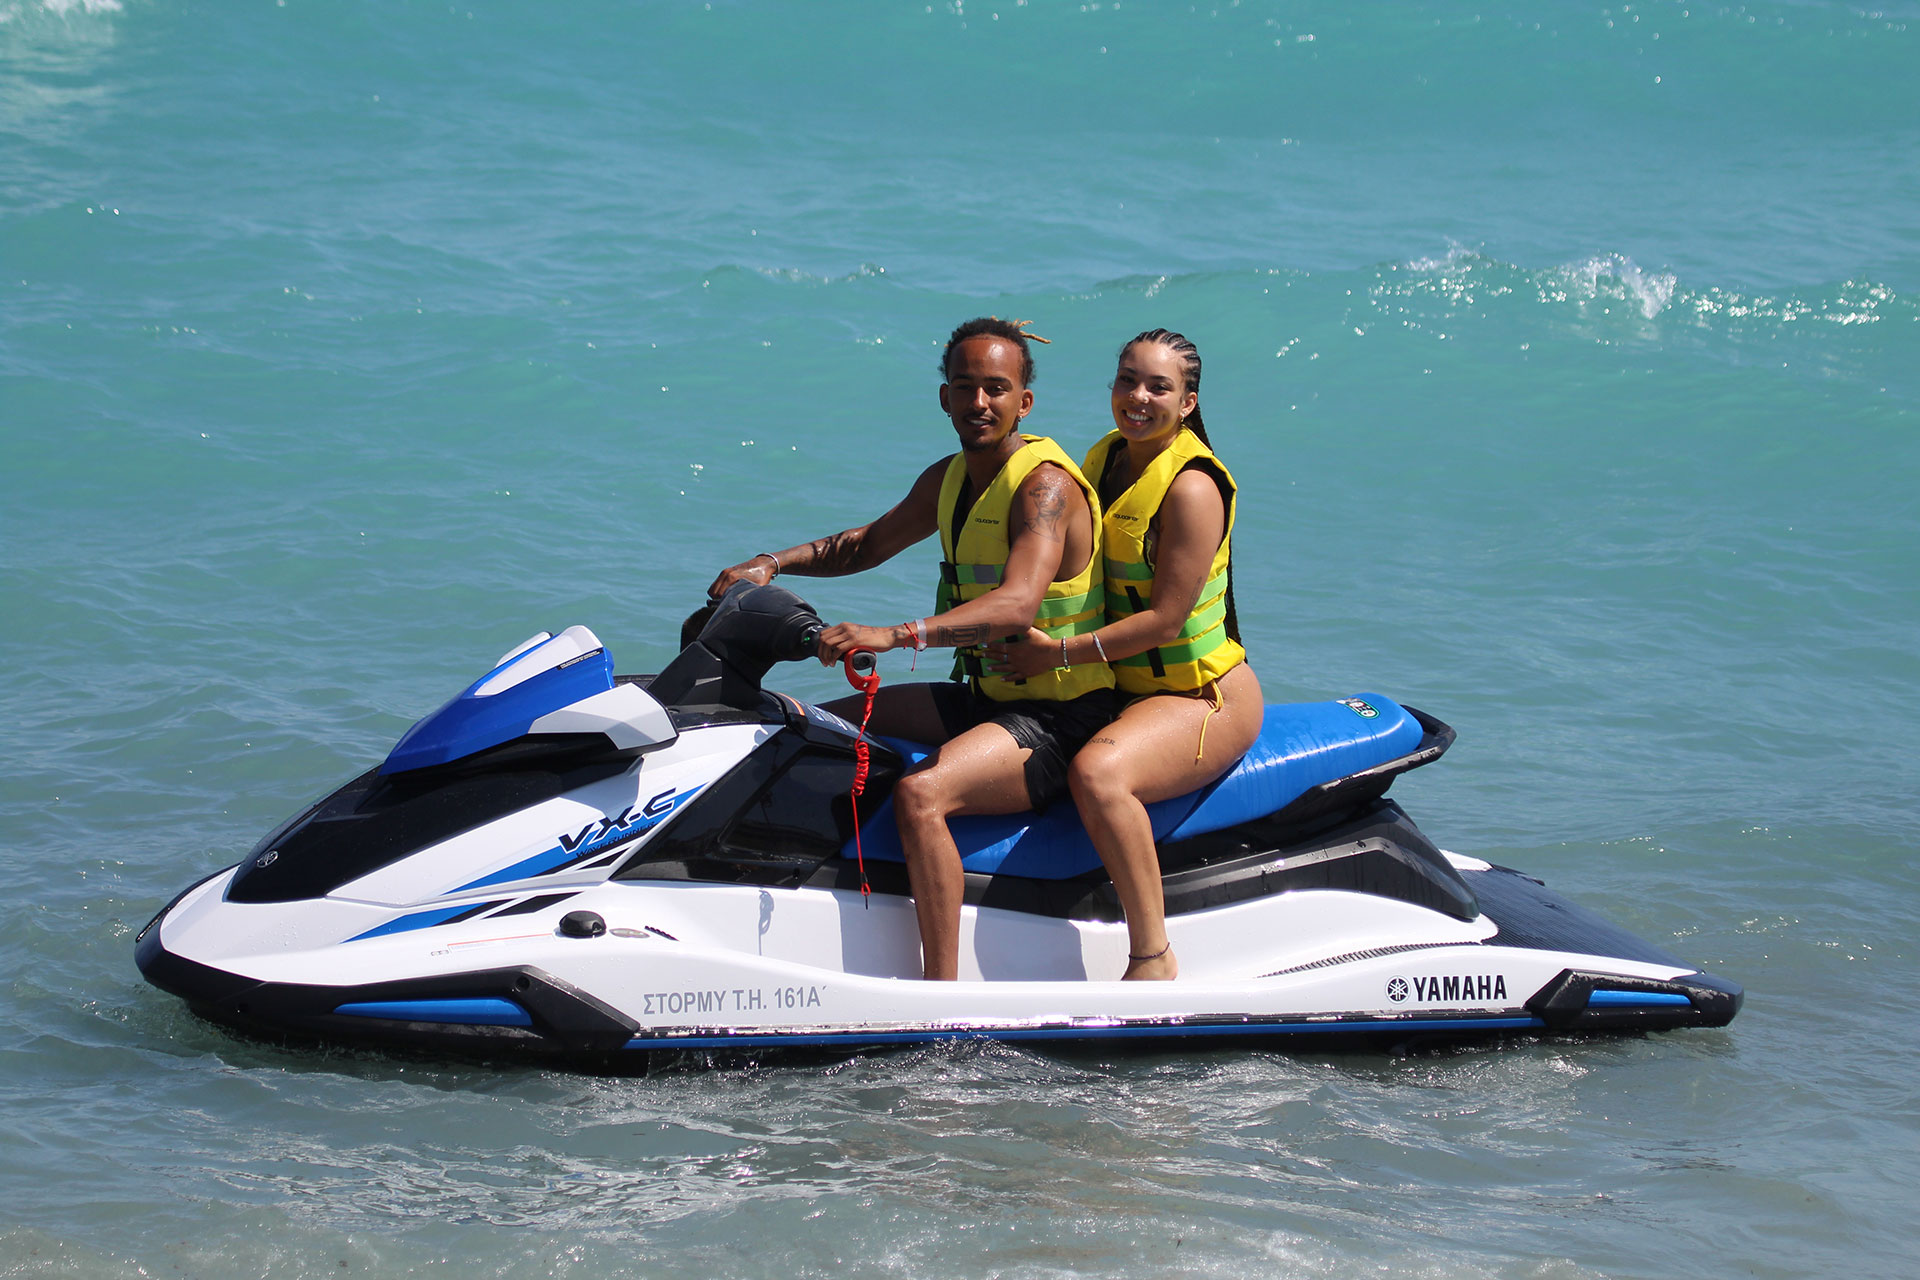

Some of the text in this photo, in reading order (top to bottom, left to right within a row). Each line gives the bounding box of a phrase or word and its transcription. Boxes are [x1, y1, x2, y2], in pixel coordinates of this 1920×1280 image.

[558, 787, 677, 853] VX-C
[575, 821, 656, 857] WAVERUNNER
[1412, 975, 1507, 1001] YAMAHA
